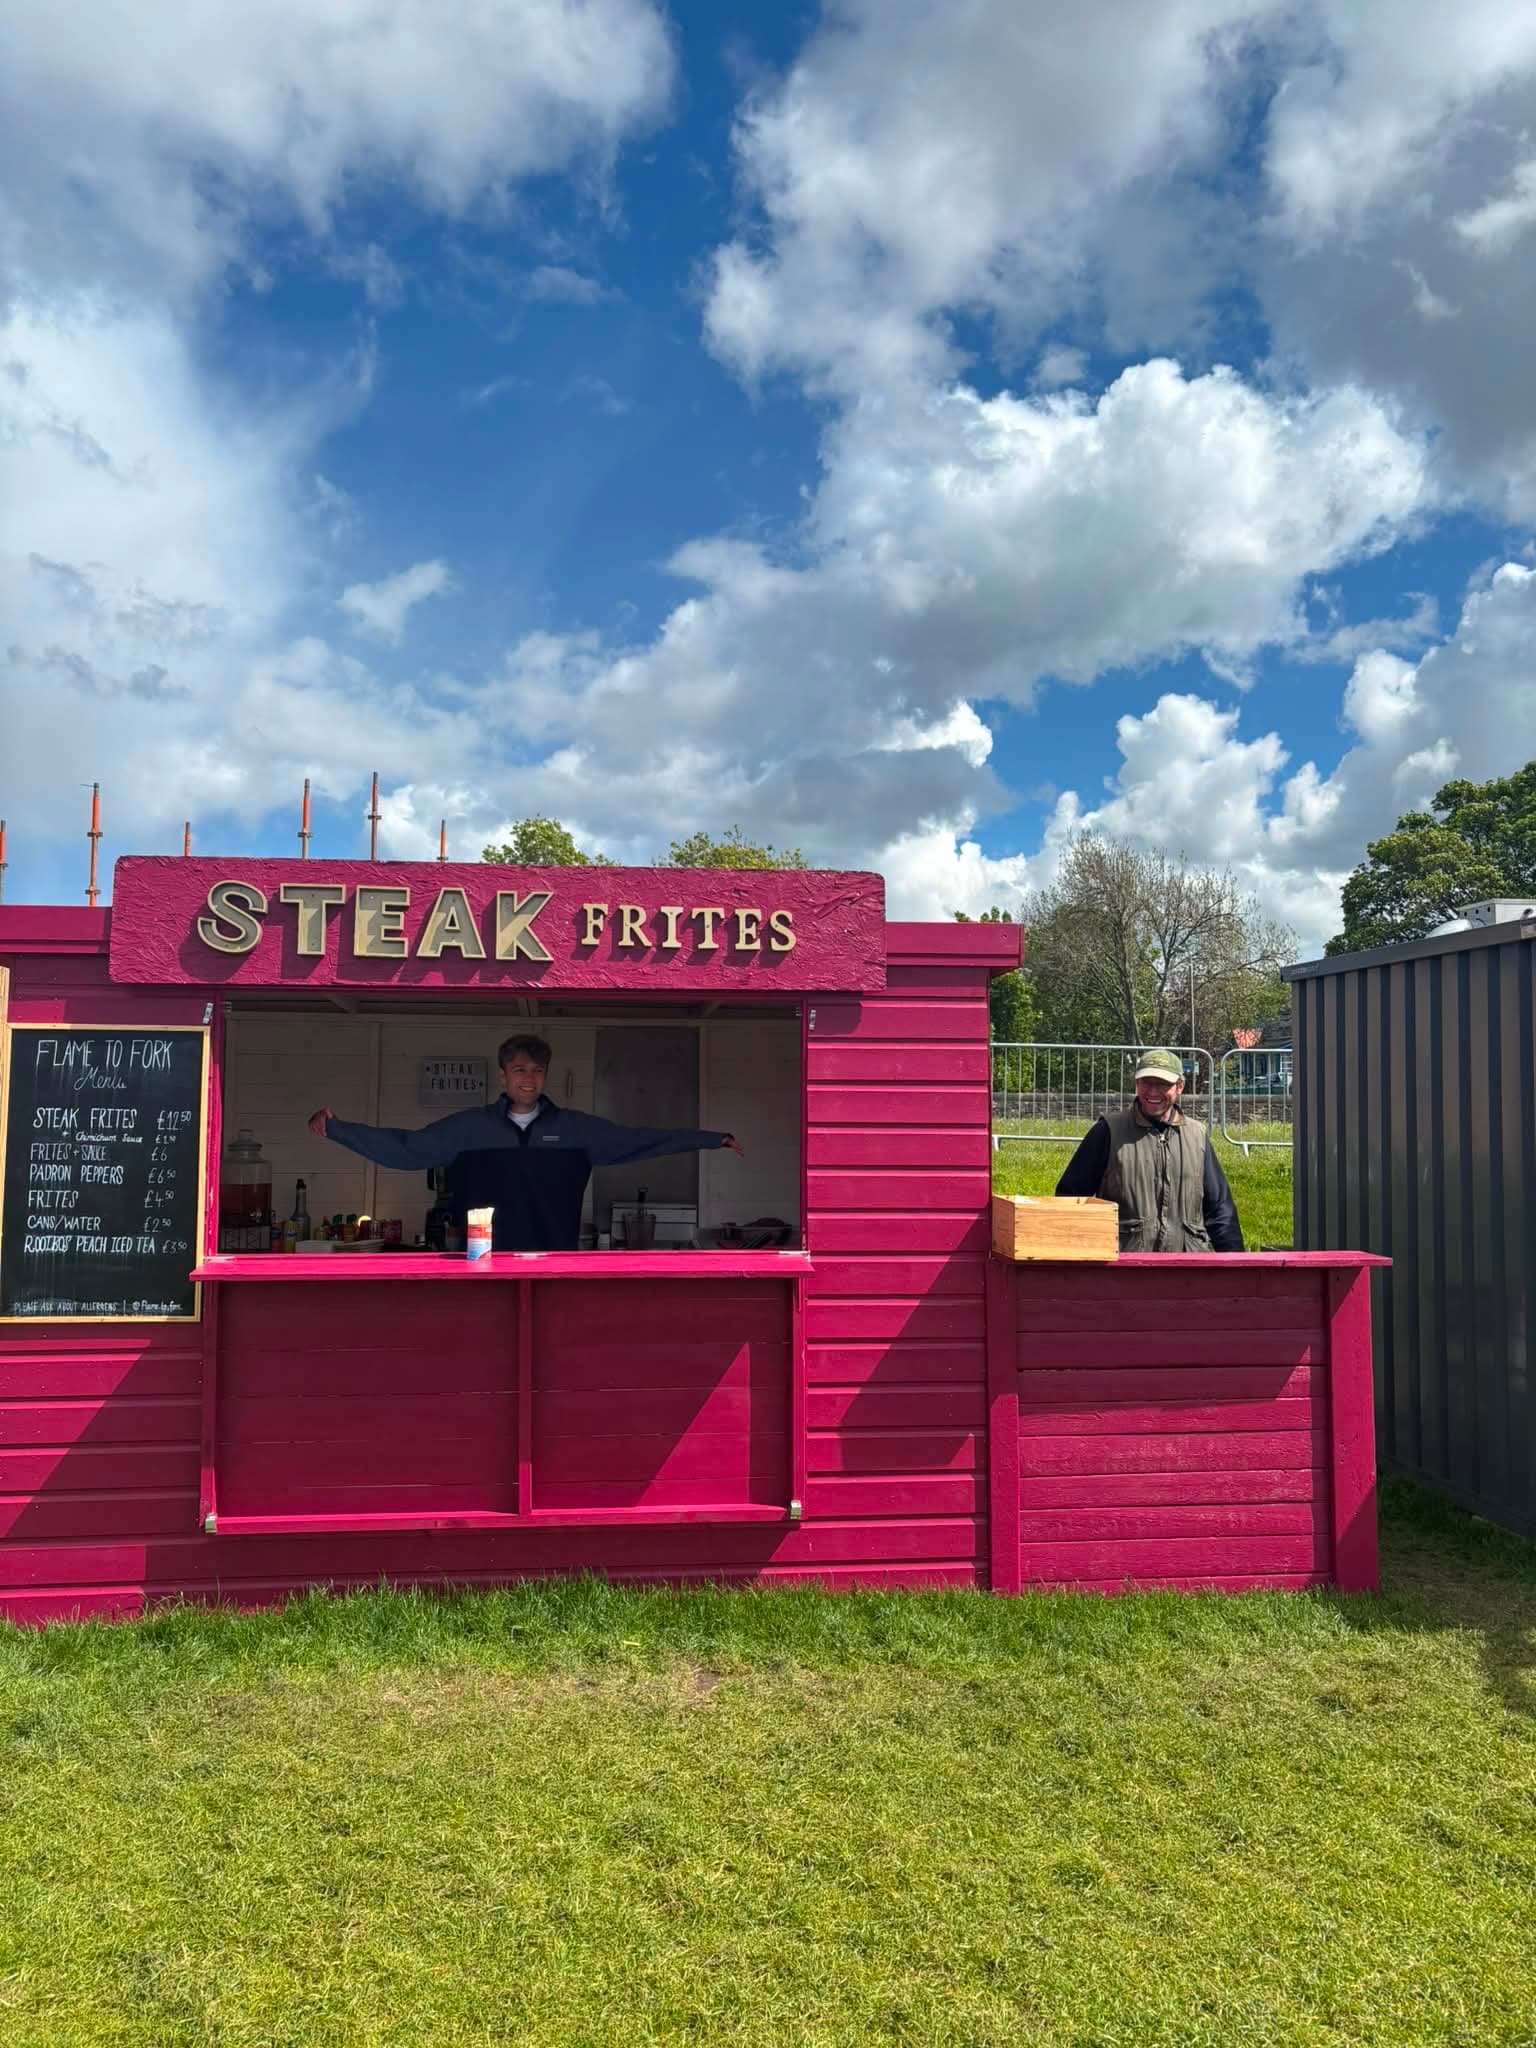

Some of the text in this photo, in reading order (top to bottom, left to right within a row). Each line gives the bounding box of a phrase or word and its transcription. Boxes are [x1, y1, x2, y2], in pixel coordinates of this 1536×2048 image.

[197, 880, 797, 961] STEAK FRITES
[36, 1040, 173, 1070] FLAME TO FORK
[74, 1066, 127, 1090] Menu
[431, 1078, 478, 1091] FRITES
[33, 1107, 79, 1128] STEAK
[90, 1108, 137, 1129] FRITES
[30, 1143, 72, 1161] FRITES
[80, 1145, 107, 1161] SAUCE
[151, 1146, 167, 1161] £6
[30, 1163, 72, 1184] PADRON
[80, 1165, 124, 1185] PEPPERS
[28, 1190, 79, 1208] FRITES
[27, 1215, 101, 1231] CANS/WATER
[24, 1235, 72, 1253] ROOIBOS
[76, 1236, 107, 1253] PEACH
[110, 1237, 133, 1253] ICED
[137, 1237, 155, 1254] TEA
[56, 1302, 77, 1313] ABOUT
